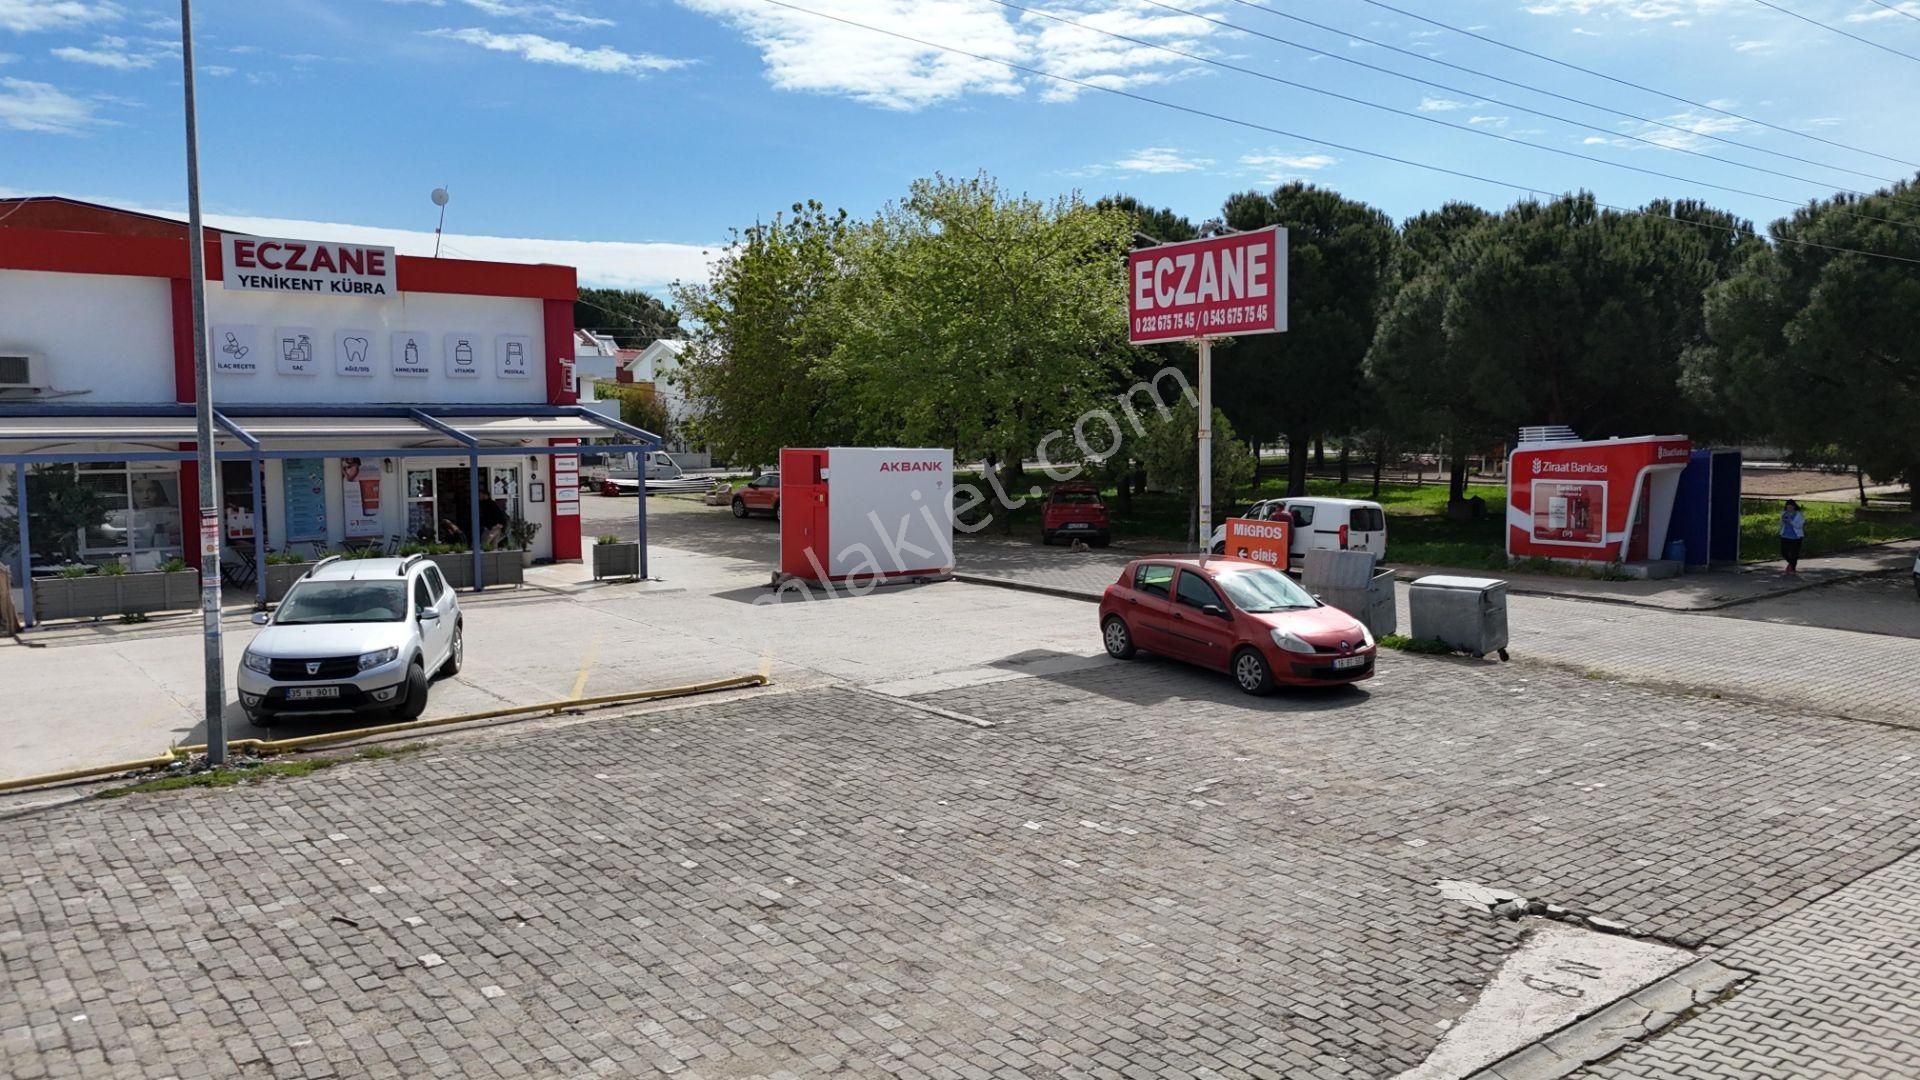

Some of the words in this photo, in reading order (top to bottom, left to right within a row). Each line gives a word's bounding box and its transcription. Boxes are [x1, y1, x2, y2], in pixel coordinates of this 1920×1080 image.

[234, 239, 386, 277] ECZANE
[238, 274, 323, 291] YENİKENT
[330, 278, 385, 295] KÜBRA
[1135, 243, 1268, 310] ECZANE
[1135, 317, 1140, 333] 0
[1142, 316, 1156, 333] 232
[1157, 315, 1172, 331] 675
[1173, 313, 1183, 329] 75
[1184, 312, 1195, 328] 45
[1196, 311, 1201, 331] /
[1203, 310, 1208, 326] 0
[1210, 308, 1225, 325] 543
[1227, 307, 1242, 324] 675
[1244, 305, 1255, 322] 75
[1256, 304, 1268, 321] 45
[879, 461, 943, 473] AKBANK
[1543, 461, 1570, 473] Ziraat
[1571, 462, 1608, 473] Bankası
[1251, 548, 1278, 565] GİRİŞ
[291, 687, 301, 697] 35
[316, 686, 338, 697] 9011
